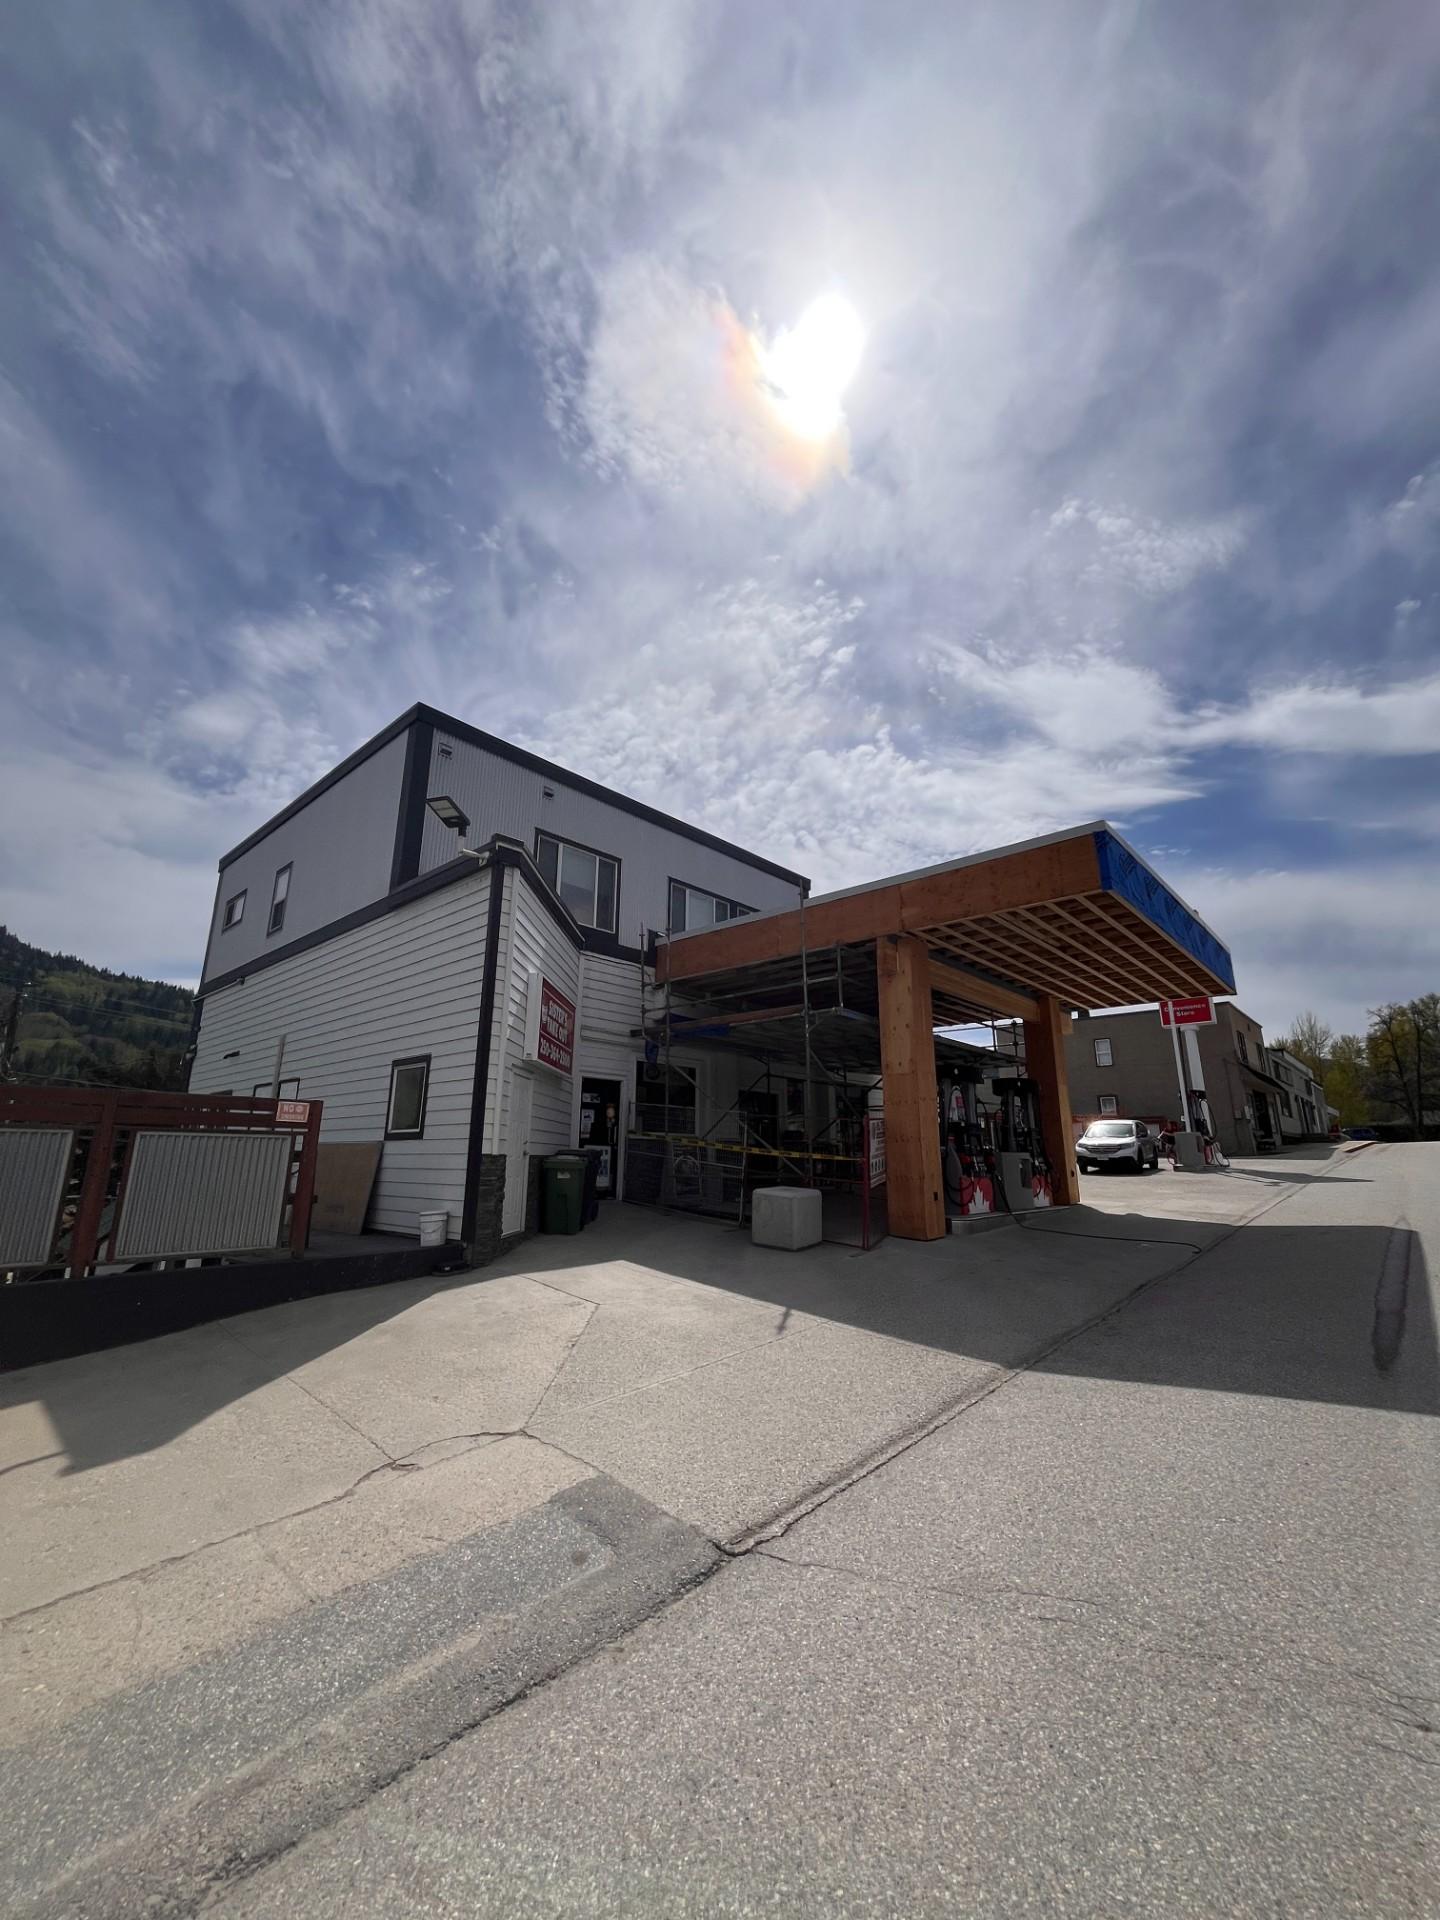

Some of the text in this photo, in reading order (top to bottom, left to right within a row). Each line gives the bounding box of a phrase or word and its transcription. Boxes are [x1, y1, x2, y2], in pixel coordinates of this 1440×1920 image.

[1164, 1003, 1206, 1012] Cnvenience
[559, 1026, 568, 1044] OUT
[283, 1103, 295, 1113] NO
